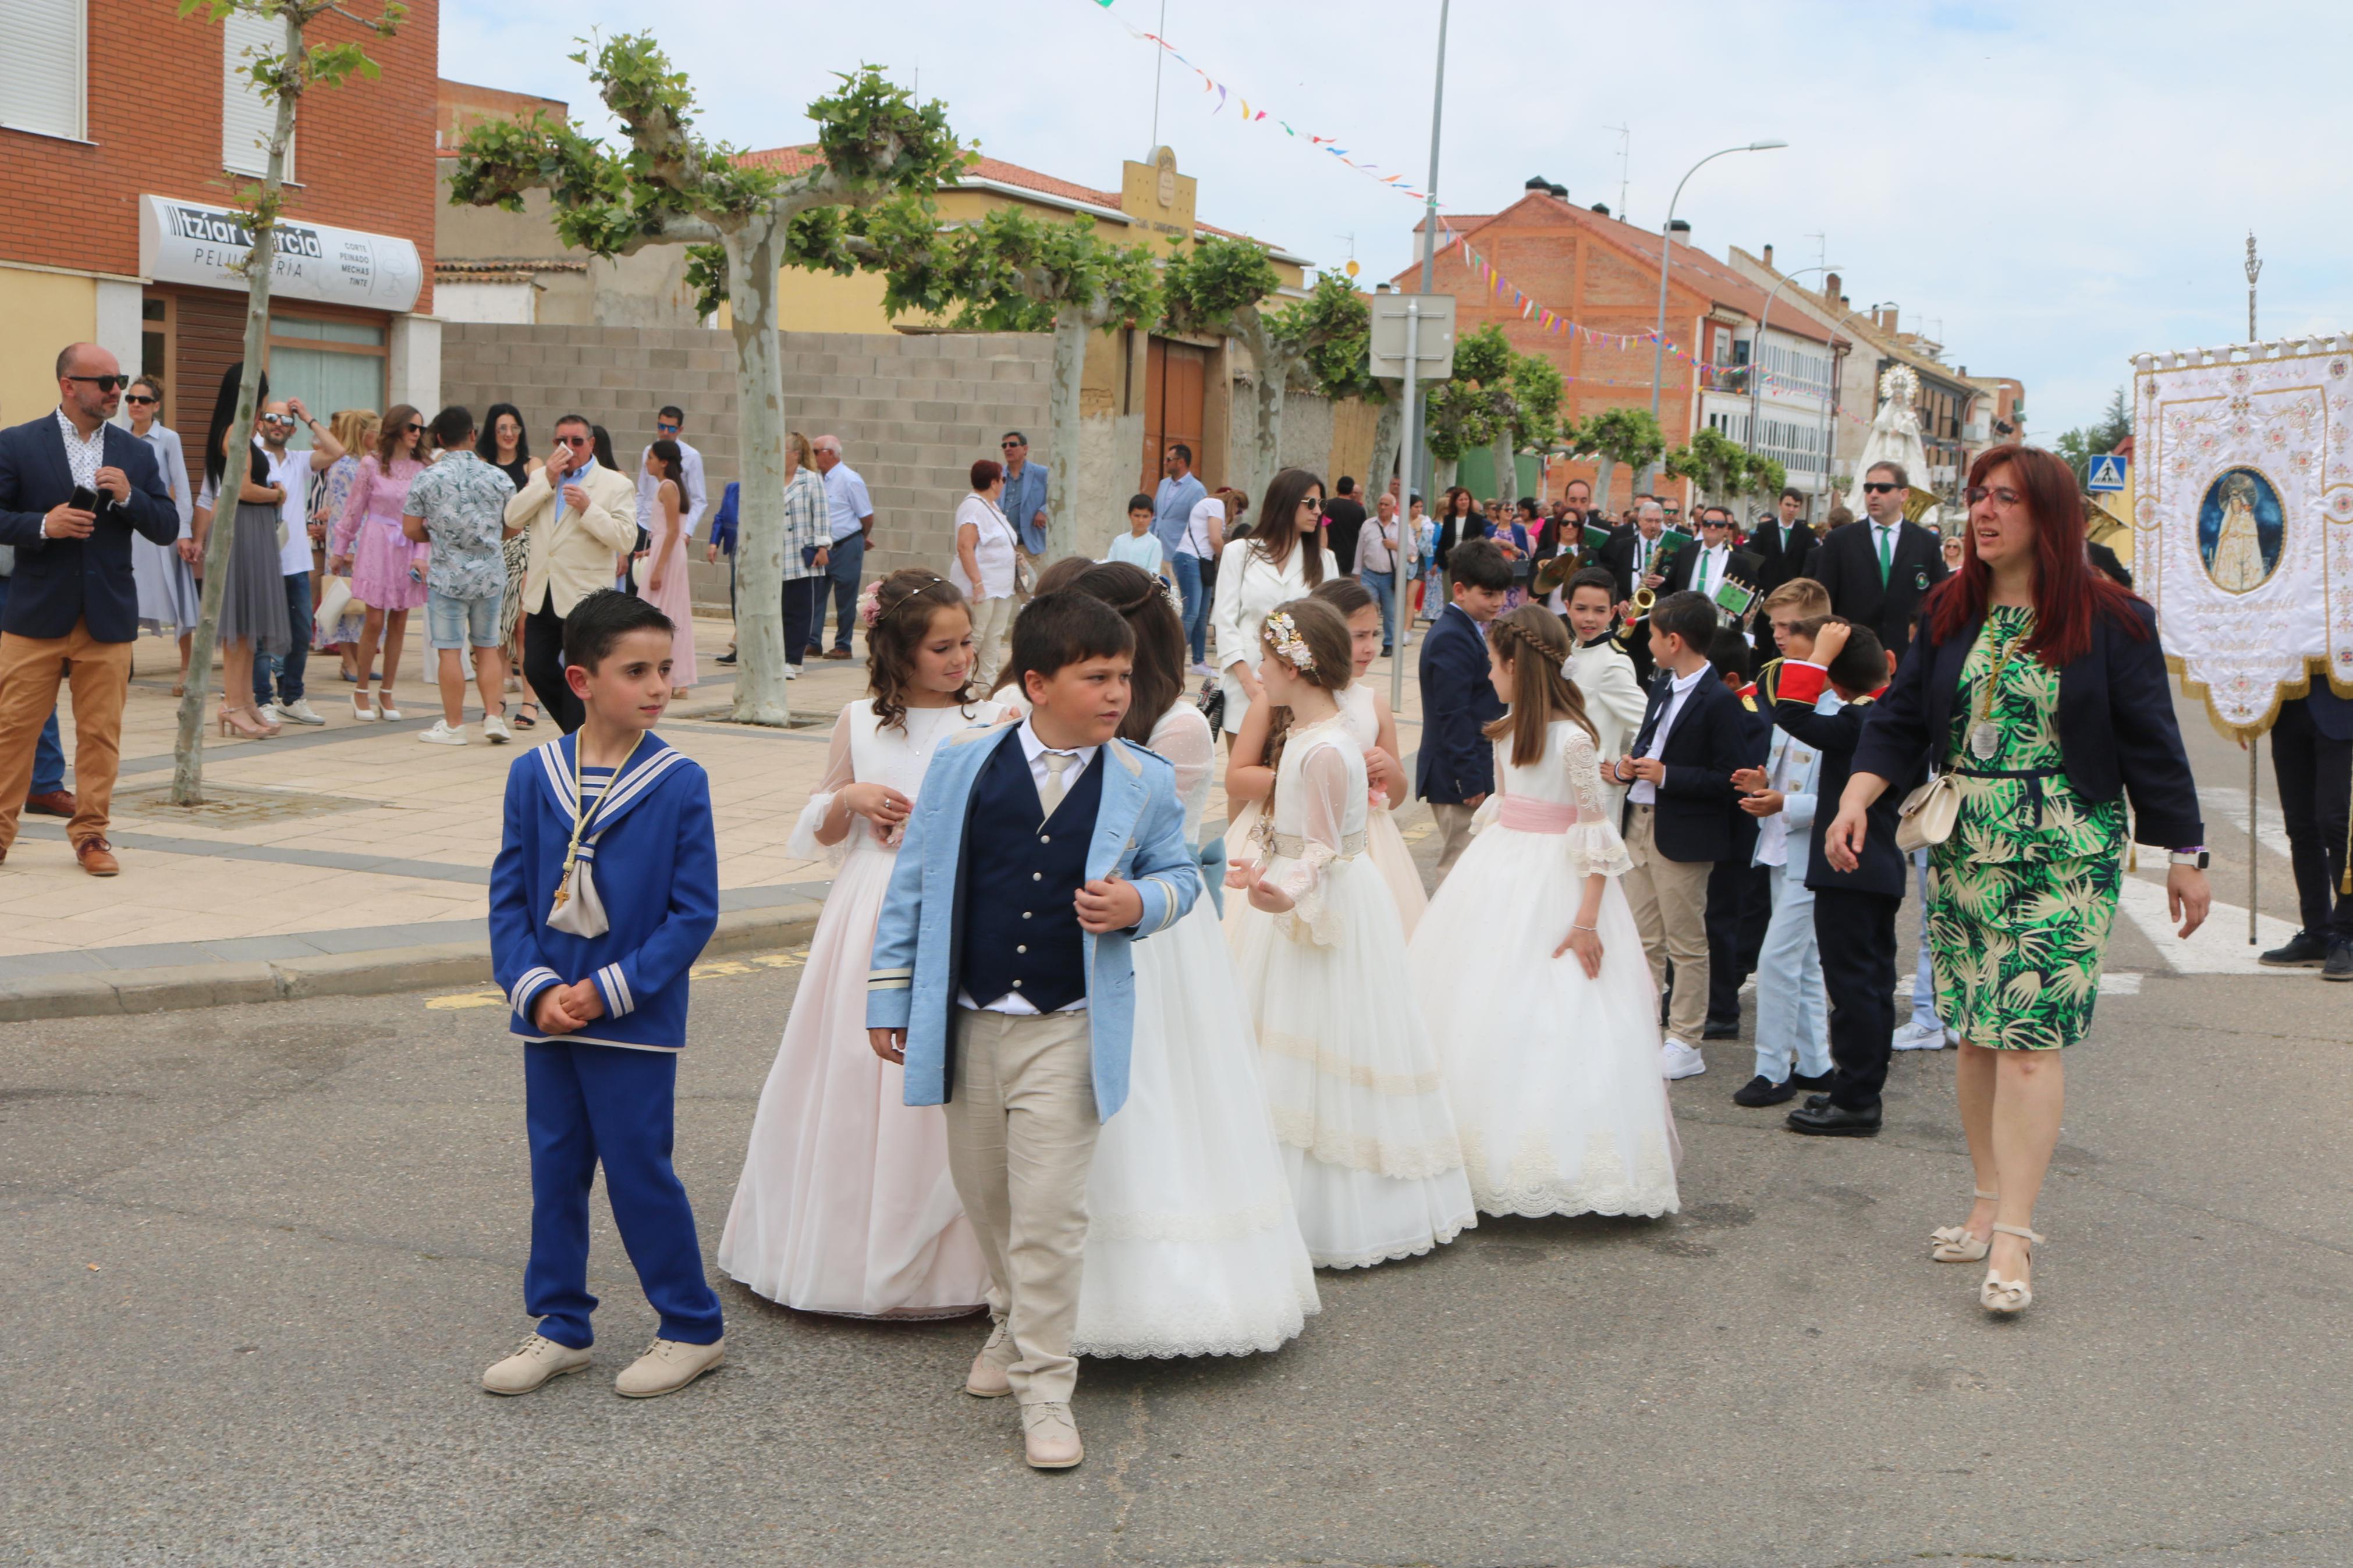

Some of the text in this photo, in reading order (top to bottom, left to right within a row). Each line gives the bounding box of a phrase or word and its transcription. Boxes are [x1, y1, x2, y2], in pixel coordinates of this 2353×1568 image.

[345, 242, 367, 252] CORTE
[340, 252, 369, 264] PEINADO
[342, 264, 369, 275] MECHAS
[350, 277, 367, 287] TINTE
